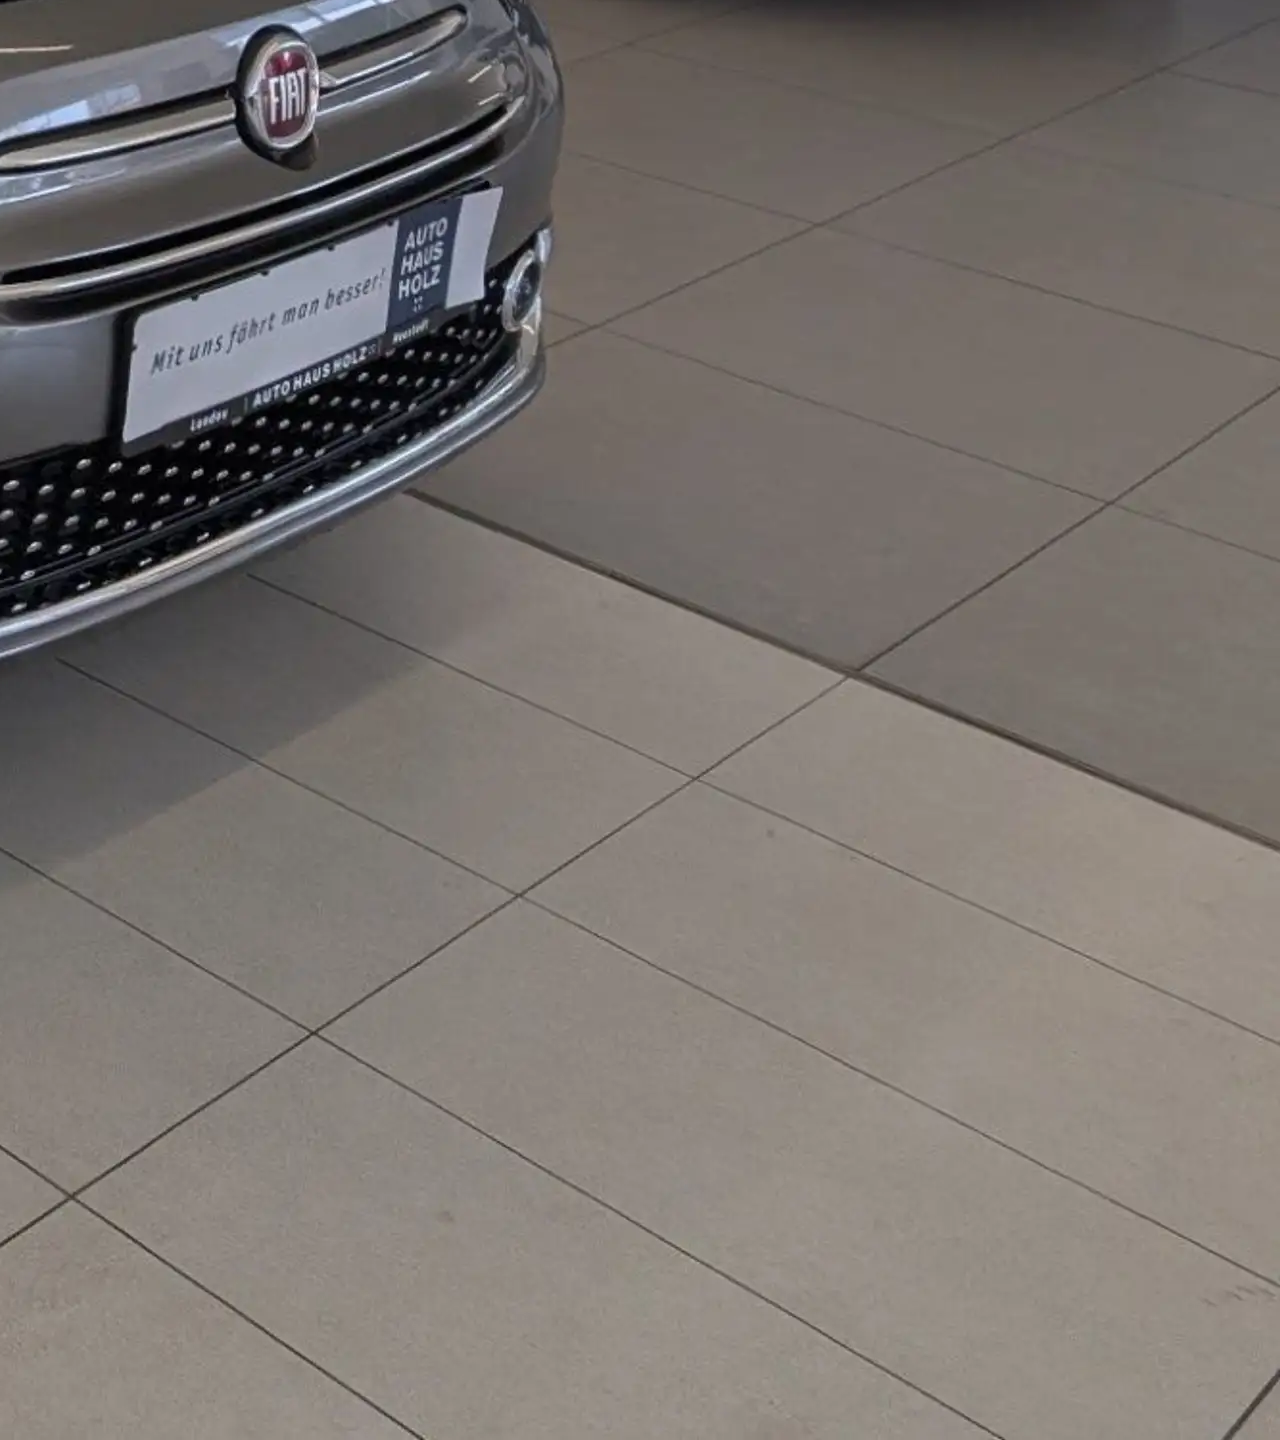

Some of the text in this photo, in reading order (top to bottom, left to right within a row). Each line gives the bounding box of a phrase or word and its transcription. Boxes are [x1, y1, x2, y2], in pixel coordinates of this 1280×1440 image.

[268, 66, 307, 124] FIAT
[401, 241, 445, 276] HAUS
[404, 217, 448, 253] AUTO
[398, 264, 441, 300] HOLZ
[150, 267, 386, 376] Mit uns fährt man besser!
[253, 346, 368, 408] AUTO HAUS HOLZ
